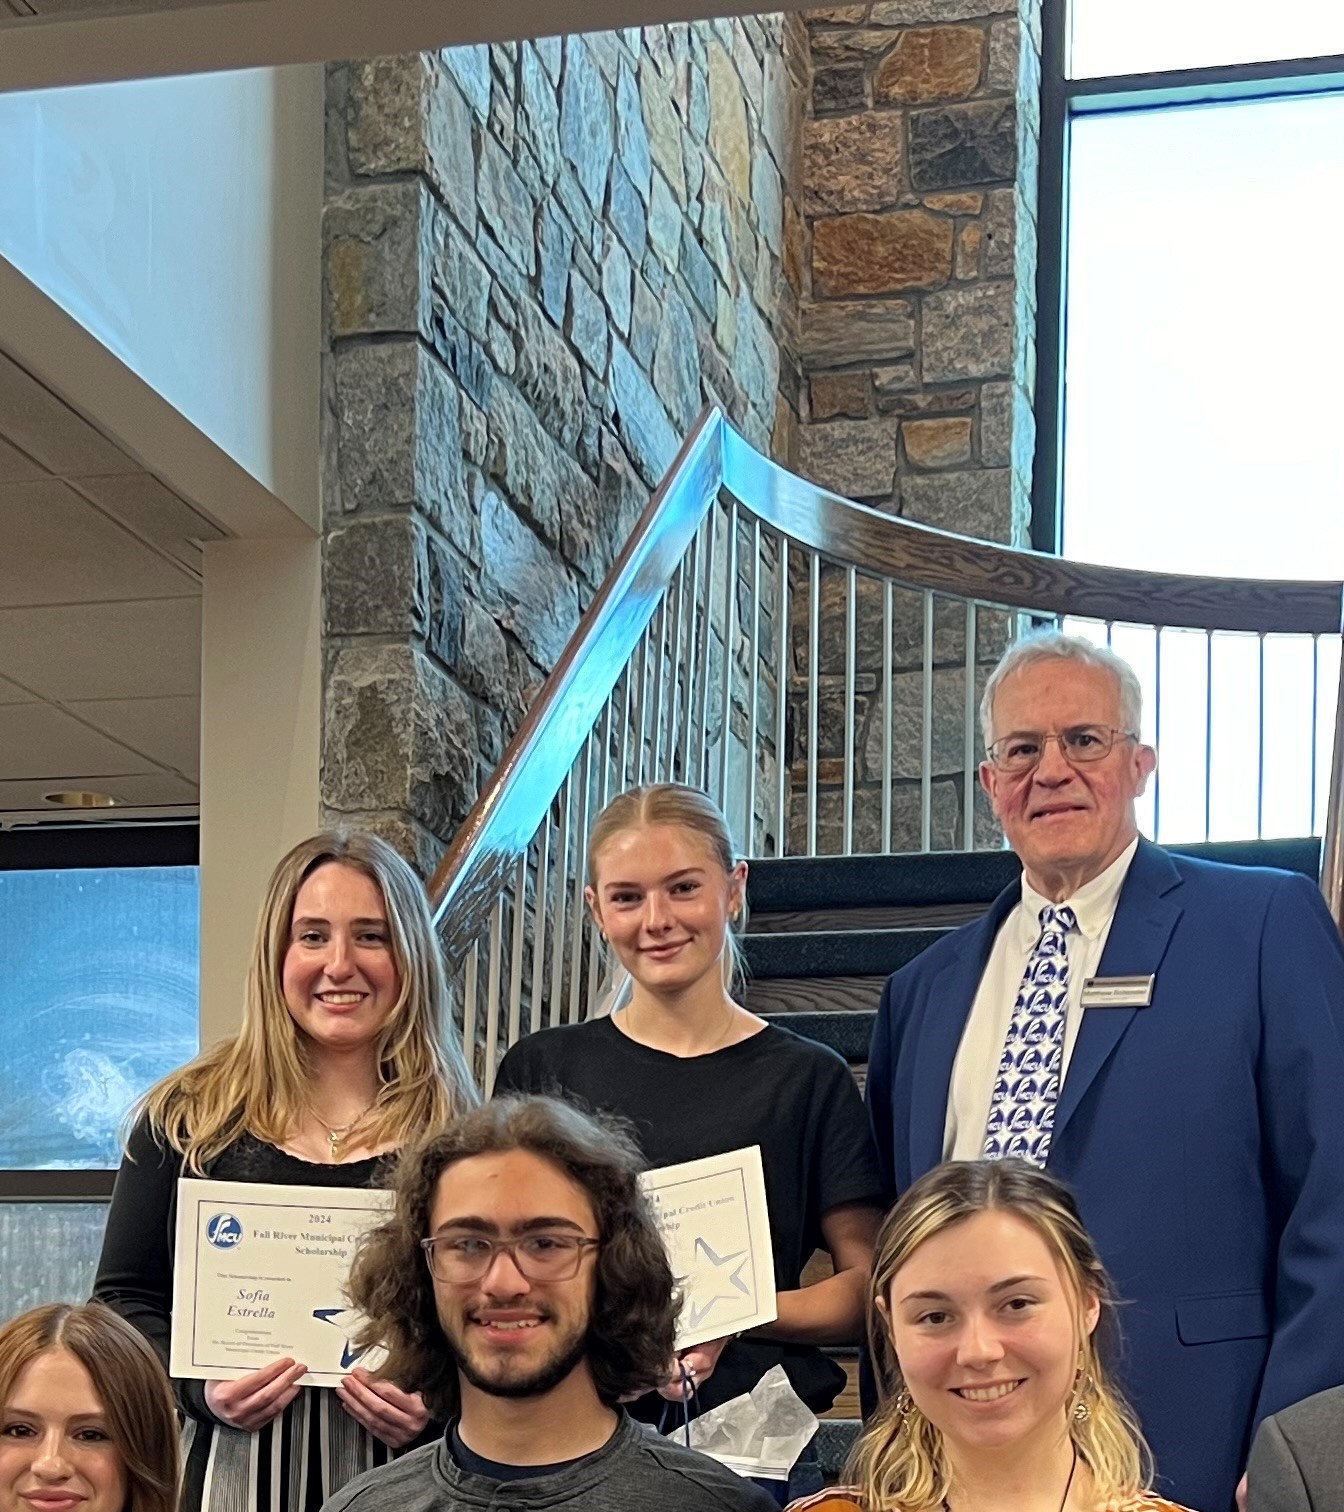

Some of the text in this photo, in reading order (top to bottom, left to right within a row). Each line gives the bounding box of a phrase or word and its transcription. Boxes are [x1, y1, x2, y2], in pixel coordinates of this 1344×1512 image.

[308, 1213, 332, 1224] 2024
[253, 1229, 271, 1239] Fall
[273, 1231, 297, 1240] River
[300, 1232, 346, 1244] Municipal
[295, 1246, 348, 1258] Scholarship
[237, 1288, 270, 1304] Sofia
[227, 1304, 276, 1319] Estrella
